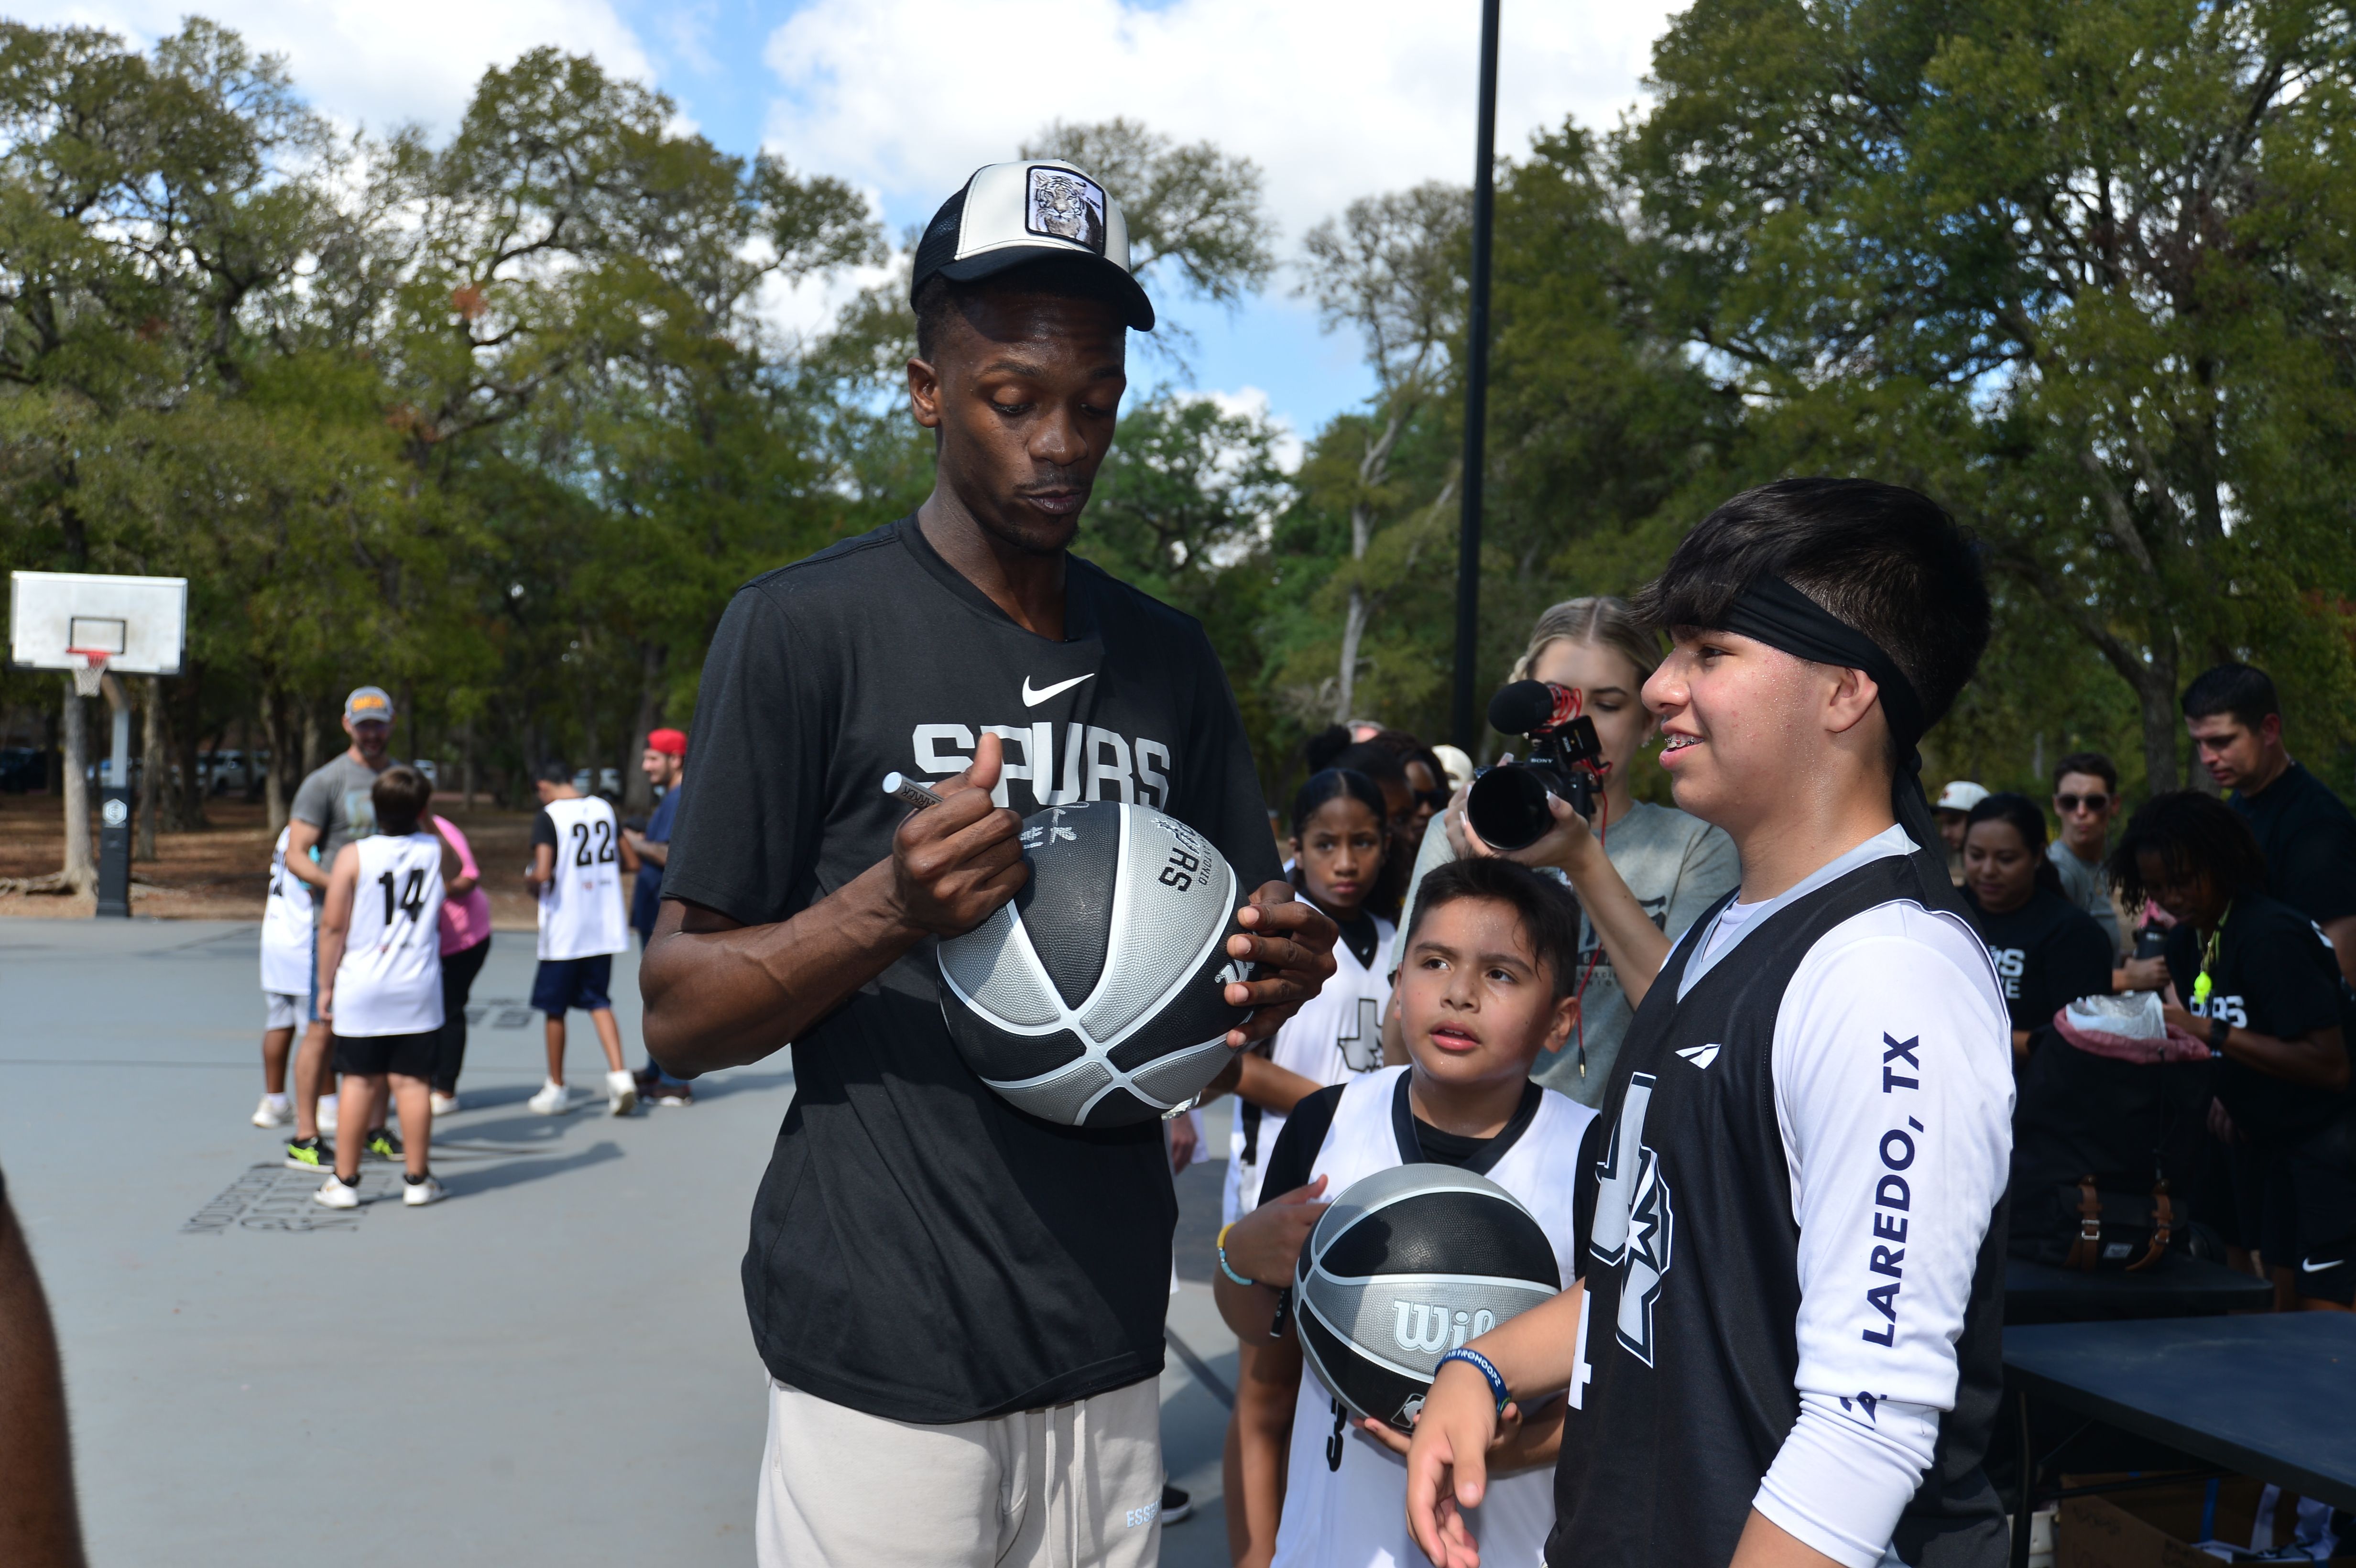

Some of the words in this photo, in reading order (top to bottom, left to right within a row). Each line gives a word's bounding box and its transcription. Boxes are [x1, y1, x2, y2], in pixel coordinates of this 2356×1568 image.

[912, 722, 1170, 812] SPURS
[573, 821, 614, 866] 22
[379, 869, 425, 926] 14
[1883, 1031, 1919, 1094] TX
[1862, 1115, 1924, 1348] LAREDO,
